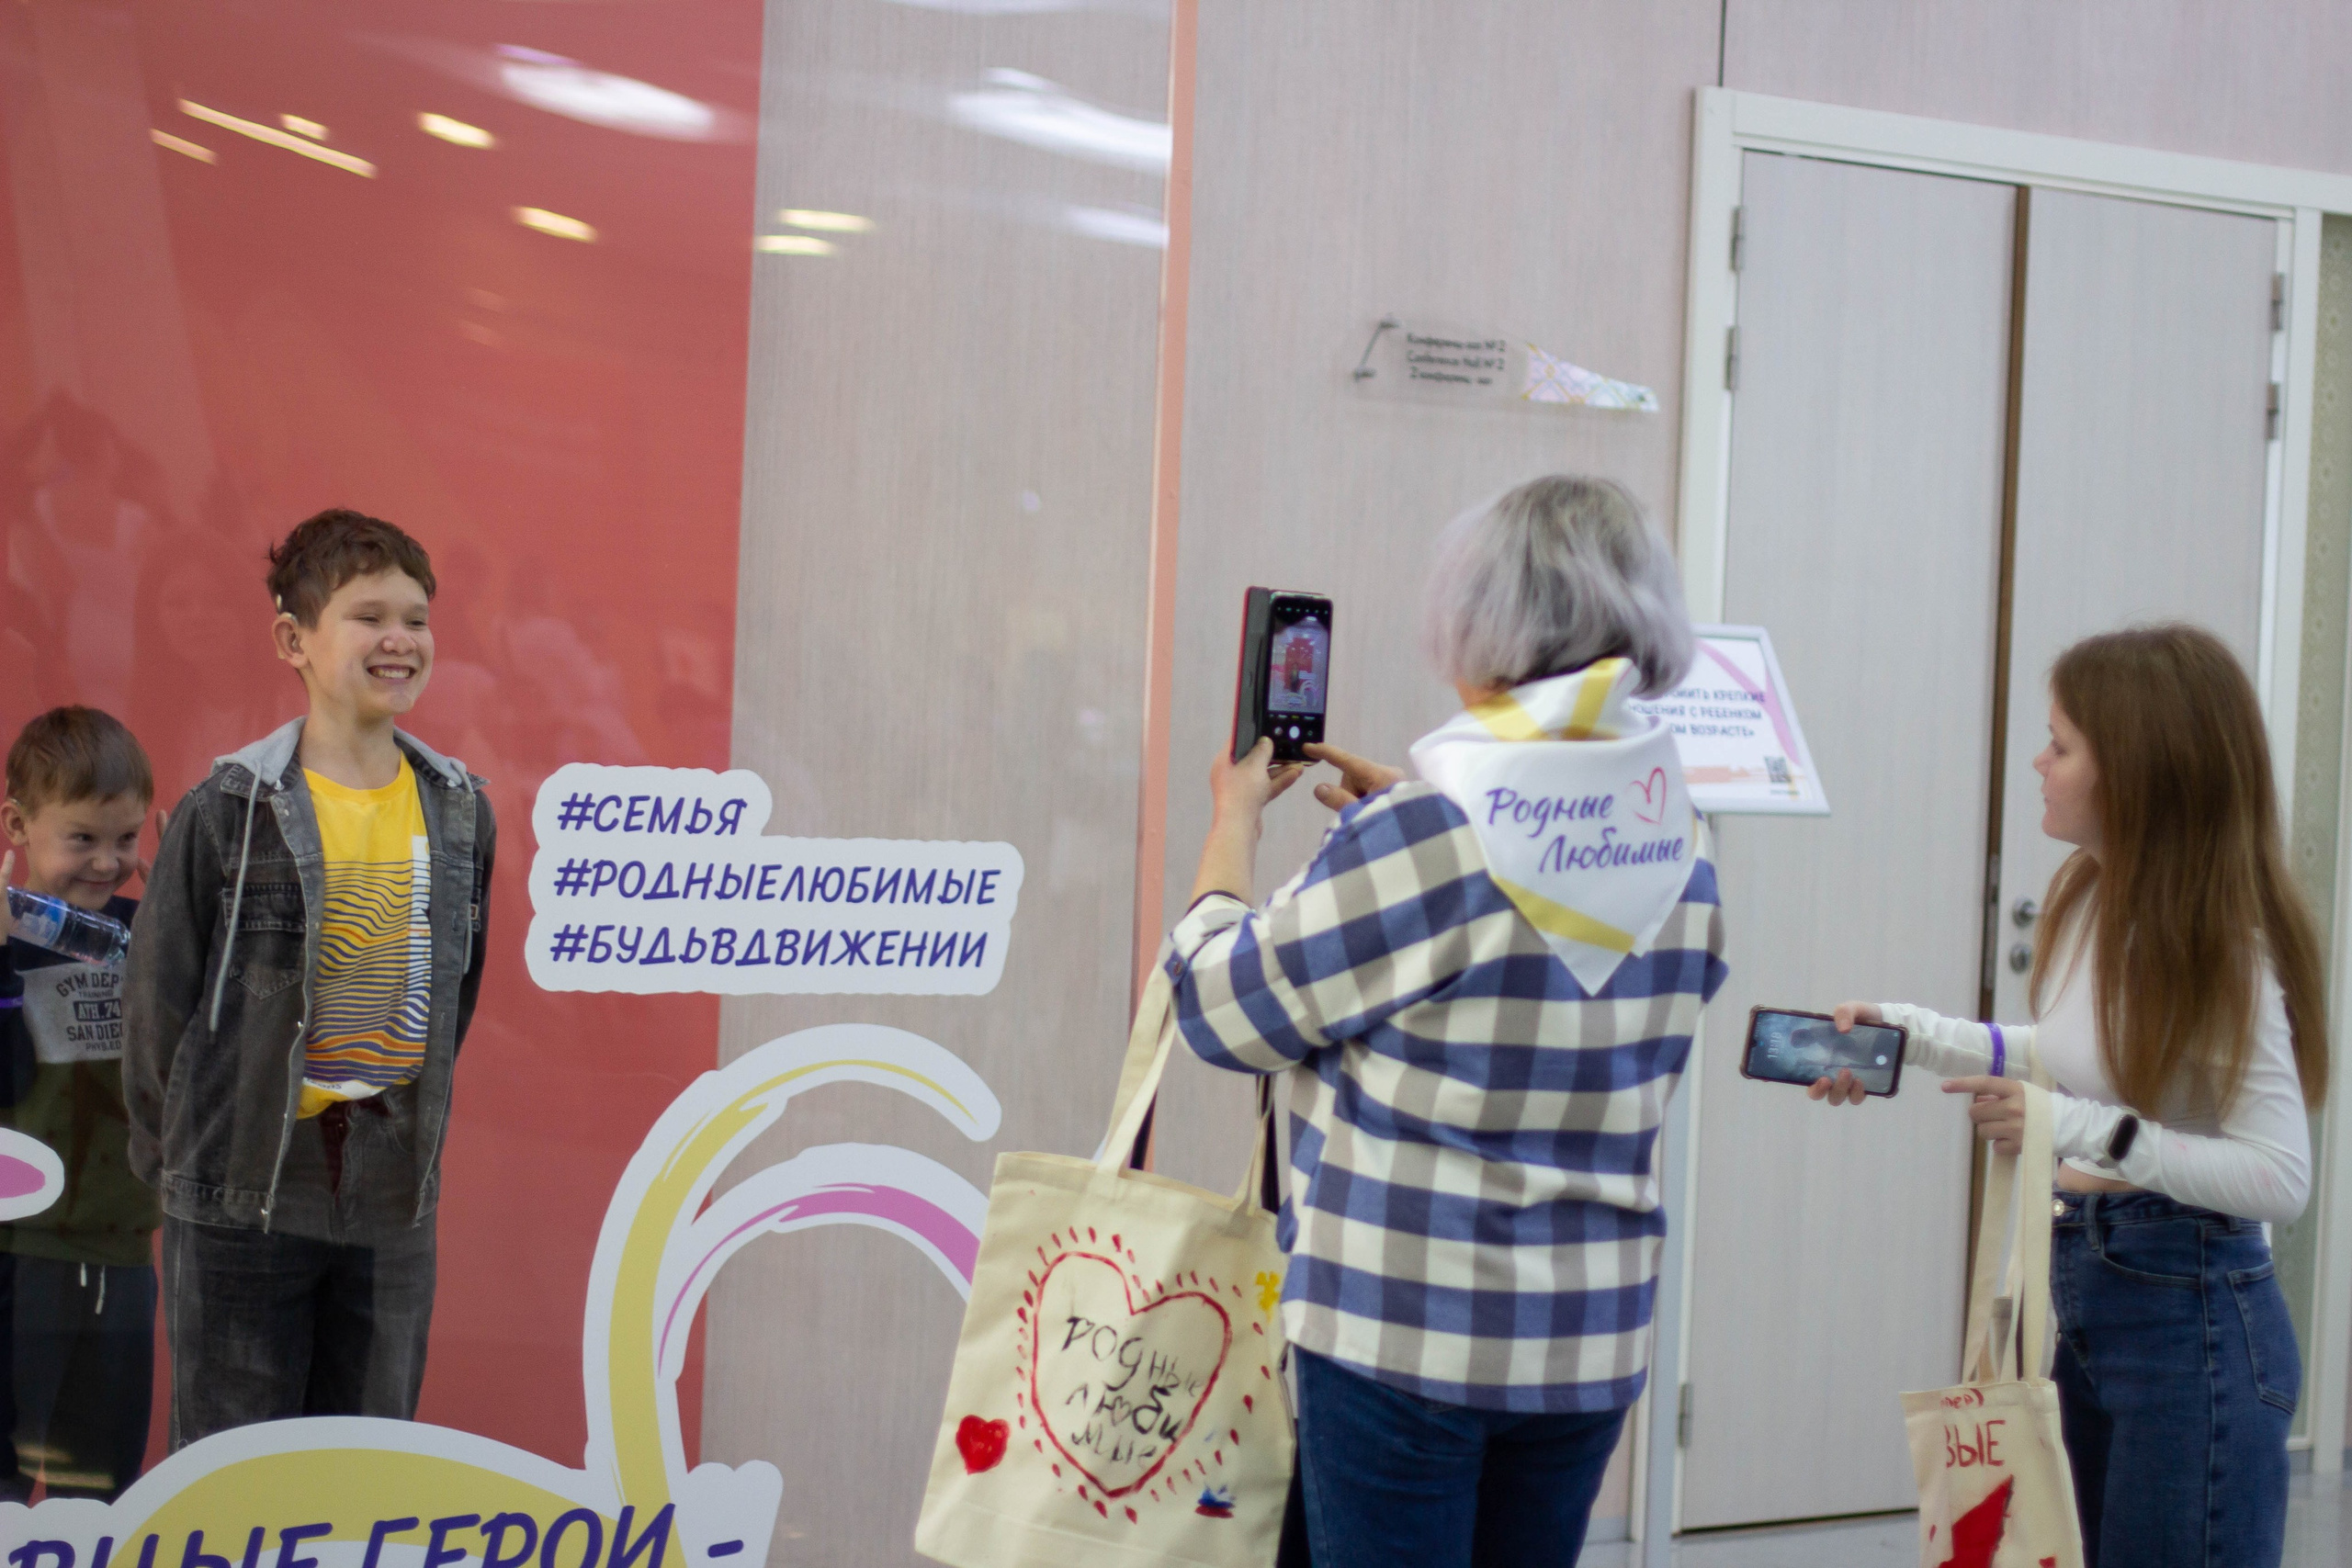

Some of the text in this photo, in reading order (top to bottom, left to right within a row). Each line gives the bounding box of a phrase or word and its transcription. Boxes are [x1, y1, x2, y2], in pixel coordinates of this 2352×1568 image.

[558, 793, 748, 835] #СЕМЬЯ
[1486, 787, 1614, 838] Родные
[1538, 827, 1683, 873] Любимые
[553, 858, 1001, 905] #РОДНЫЕЛЮБИМЫЕ
[550, 924, 989, 967] #БУДЬВДВИЖЕНИИ
[56, 972, 123, 998] GYM DEP
[66, 1022, 123, 1042] SAN DIE
[345, 1503, 676, 1568] ГЕРОИ
